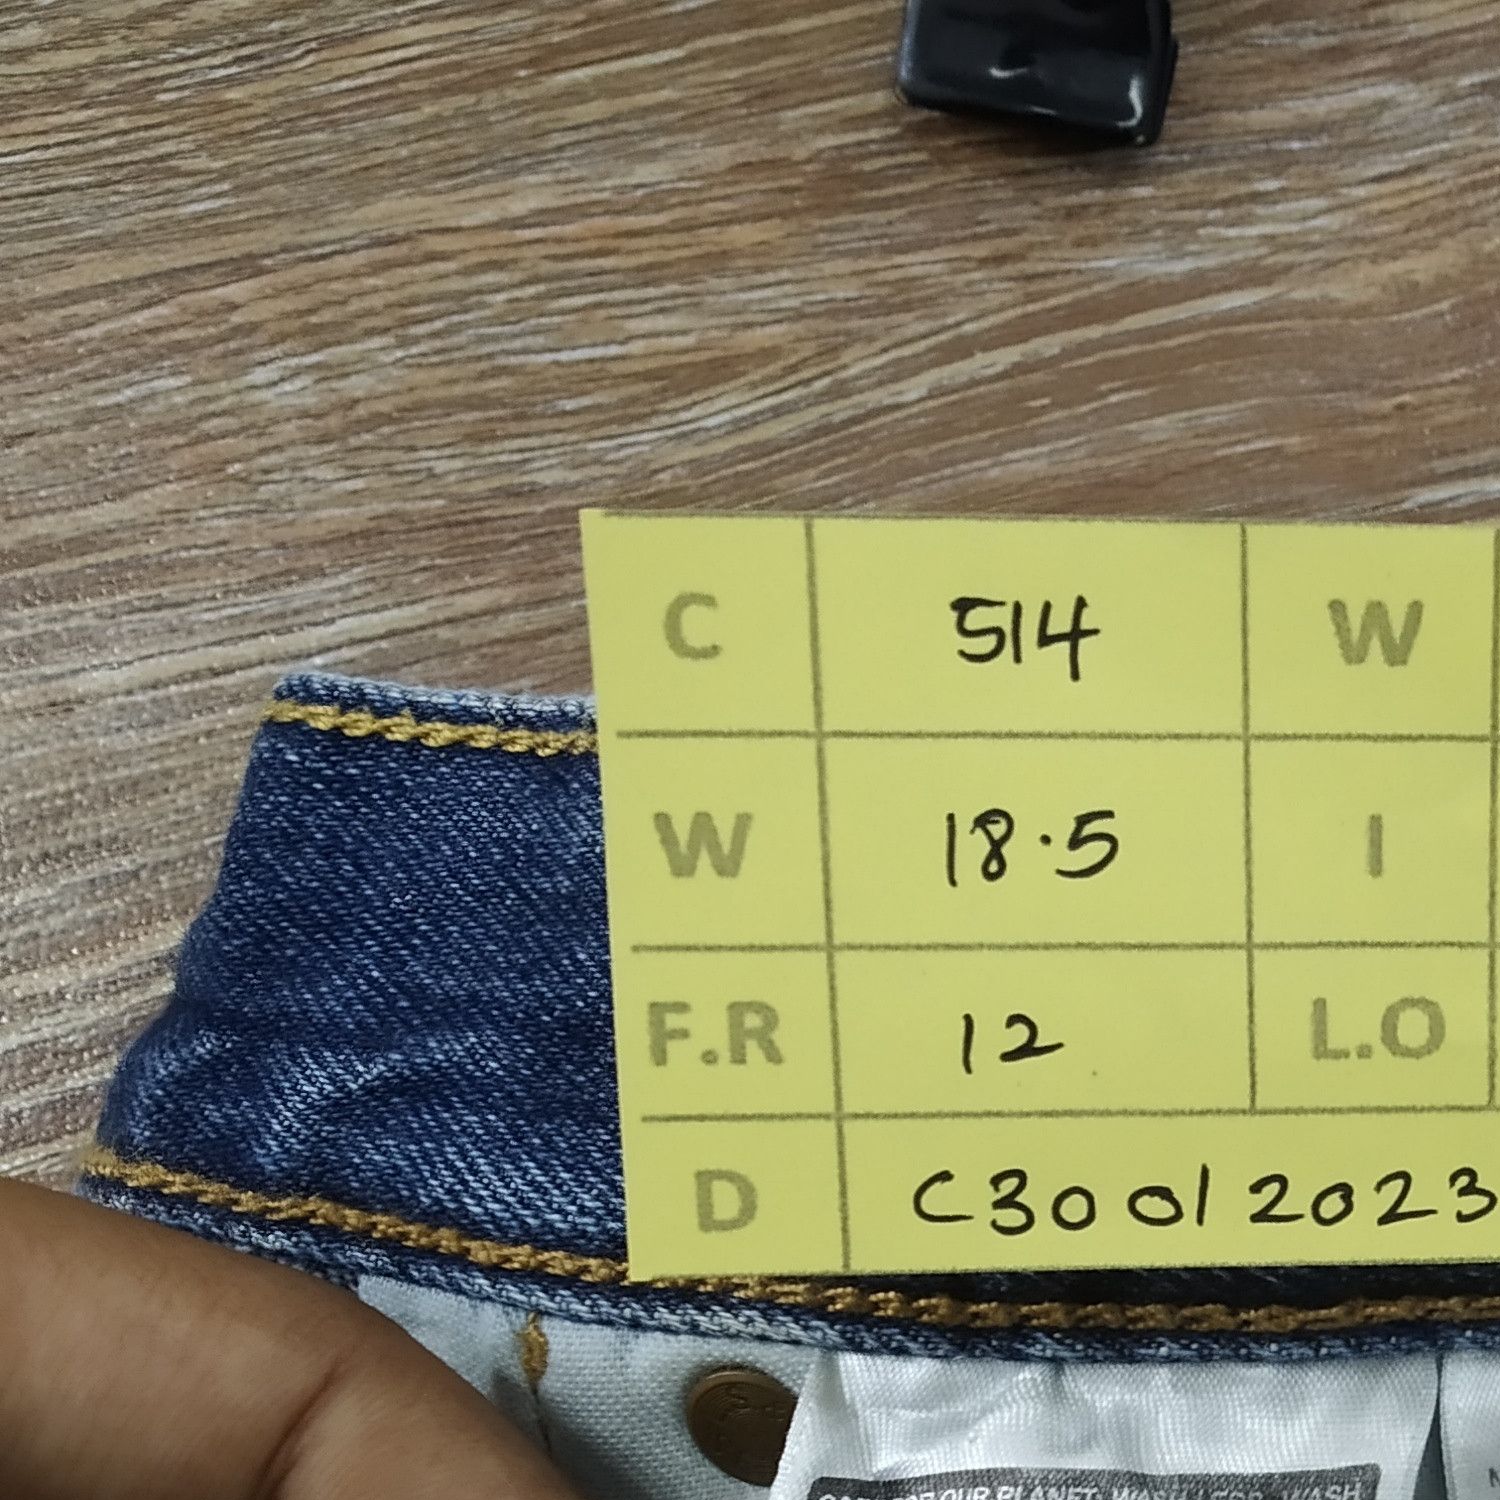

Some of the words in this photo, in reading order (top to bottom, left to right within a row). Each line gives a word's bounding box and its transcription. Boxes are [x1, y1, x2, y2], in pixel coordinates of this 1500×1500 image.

[664, 591, 723, 660] C
[950, 595, 1101, 682] 514
[1329, 598, 1424, 667] W
[652, 809, 752, 880] W
[944, 808, 1120, 888] 18.5
[1365, 813, 1384, 878] I
[647, 1001, 784, 1066] F.R
[961, 1012, 1065, 1076] 12
[1311, 997, 1446, 1061] L.O
[692, 1169, 758, 1232] D
